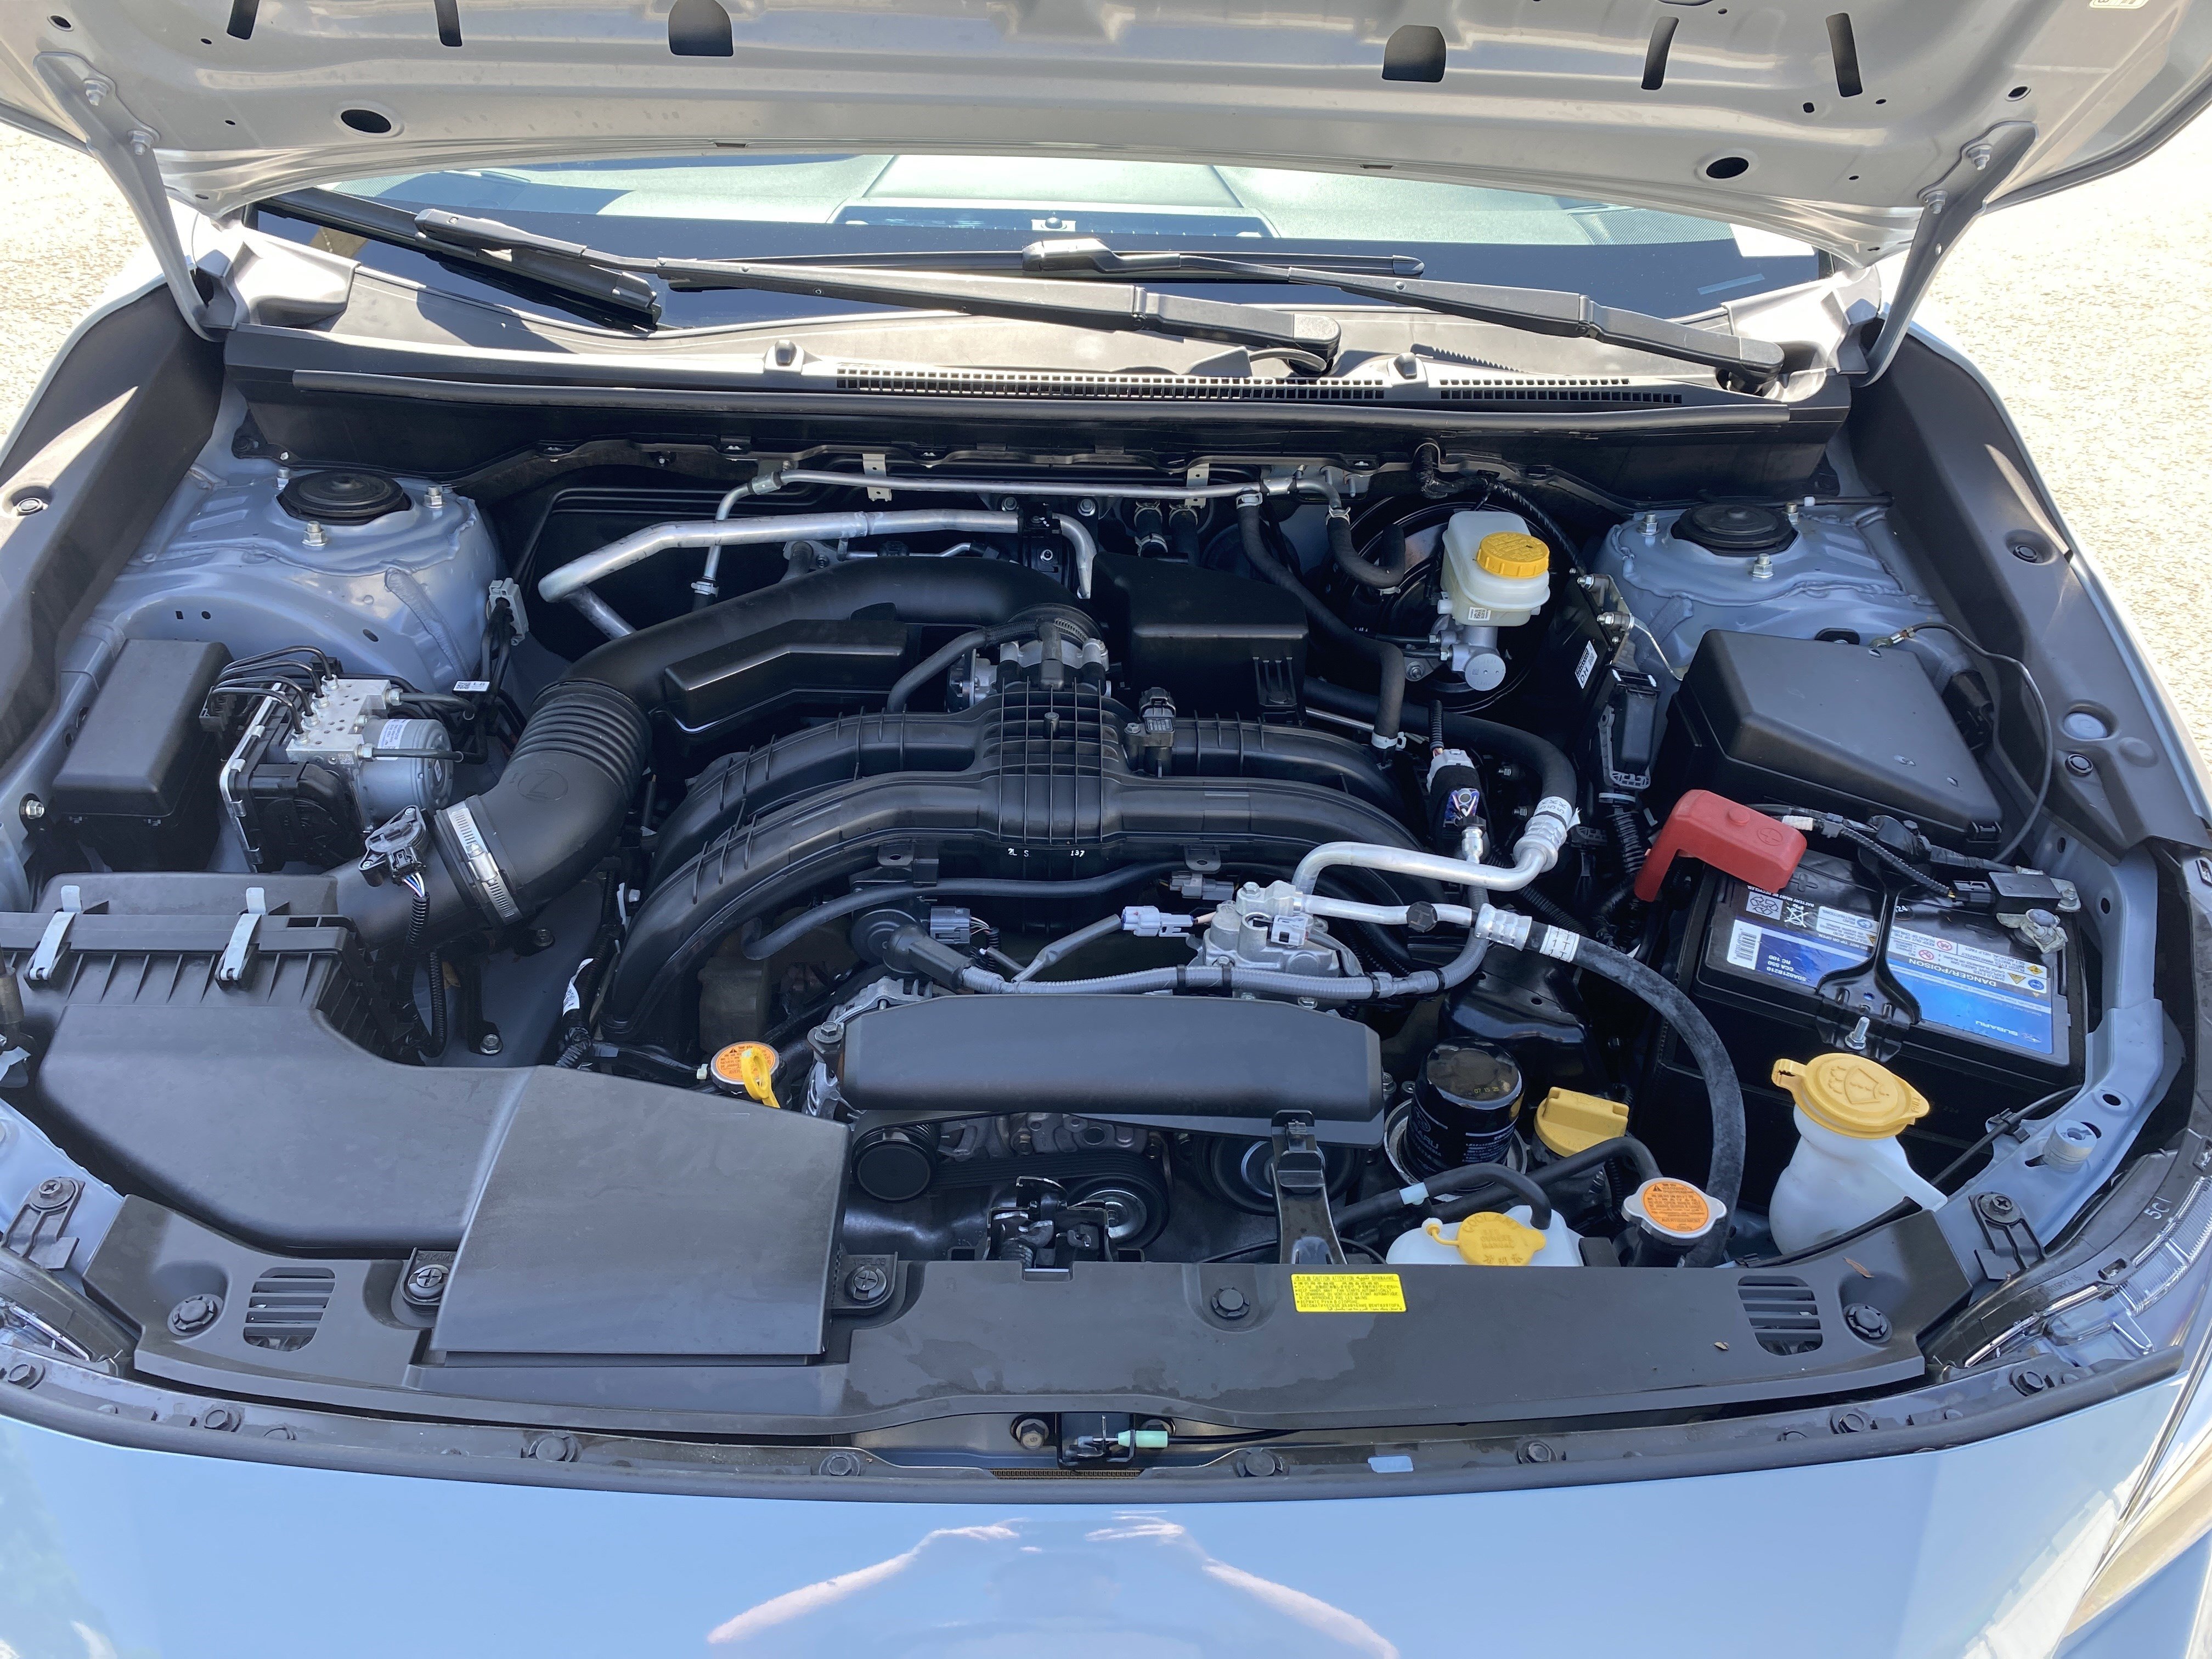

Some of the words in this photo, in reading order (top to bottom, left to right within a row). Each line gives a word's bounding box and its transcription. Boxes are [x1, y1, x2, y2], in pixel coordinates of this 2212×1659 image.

[1538, 799, 1549, 810] 5K
[1547, 799, 1558, 810] 5K
[1558, 802, 1567, 814] 5K
[1793, 898, 1814, 907] BATTERY
[1908, 958, 1997, 986] DANGER/POISON
[1974, 1020, 2018, 1036] SUBARU
